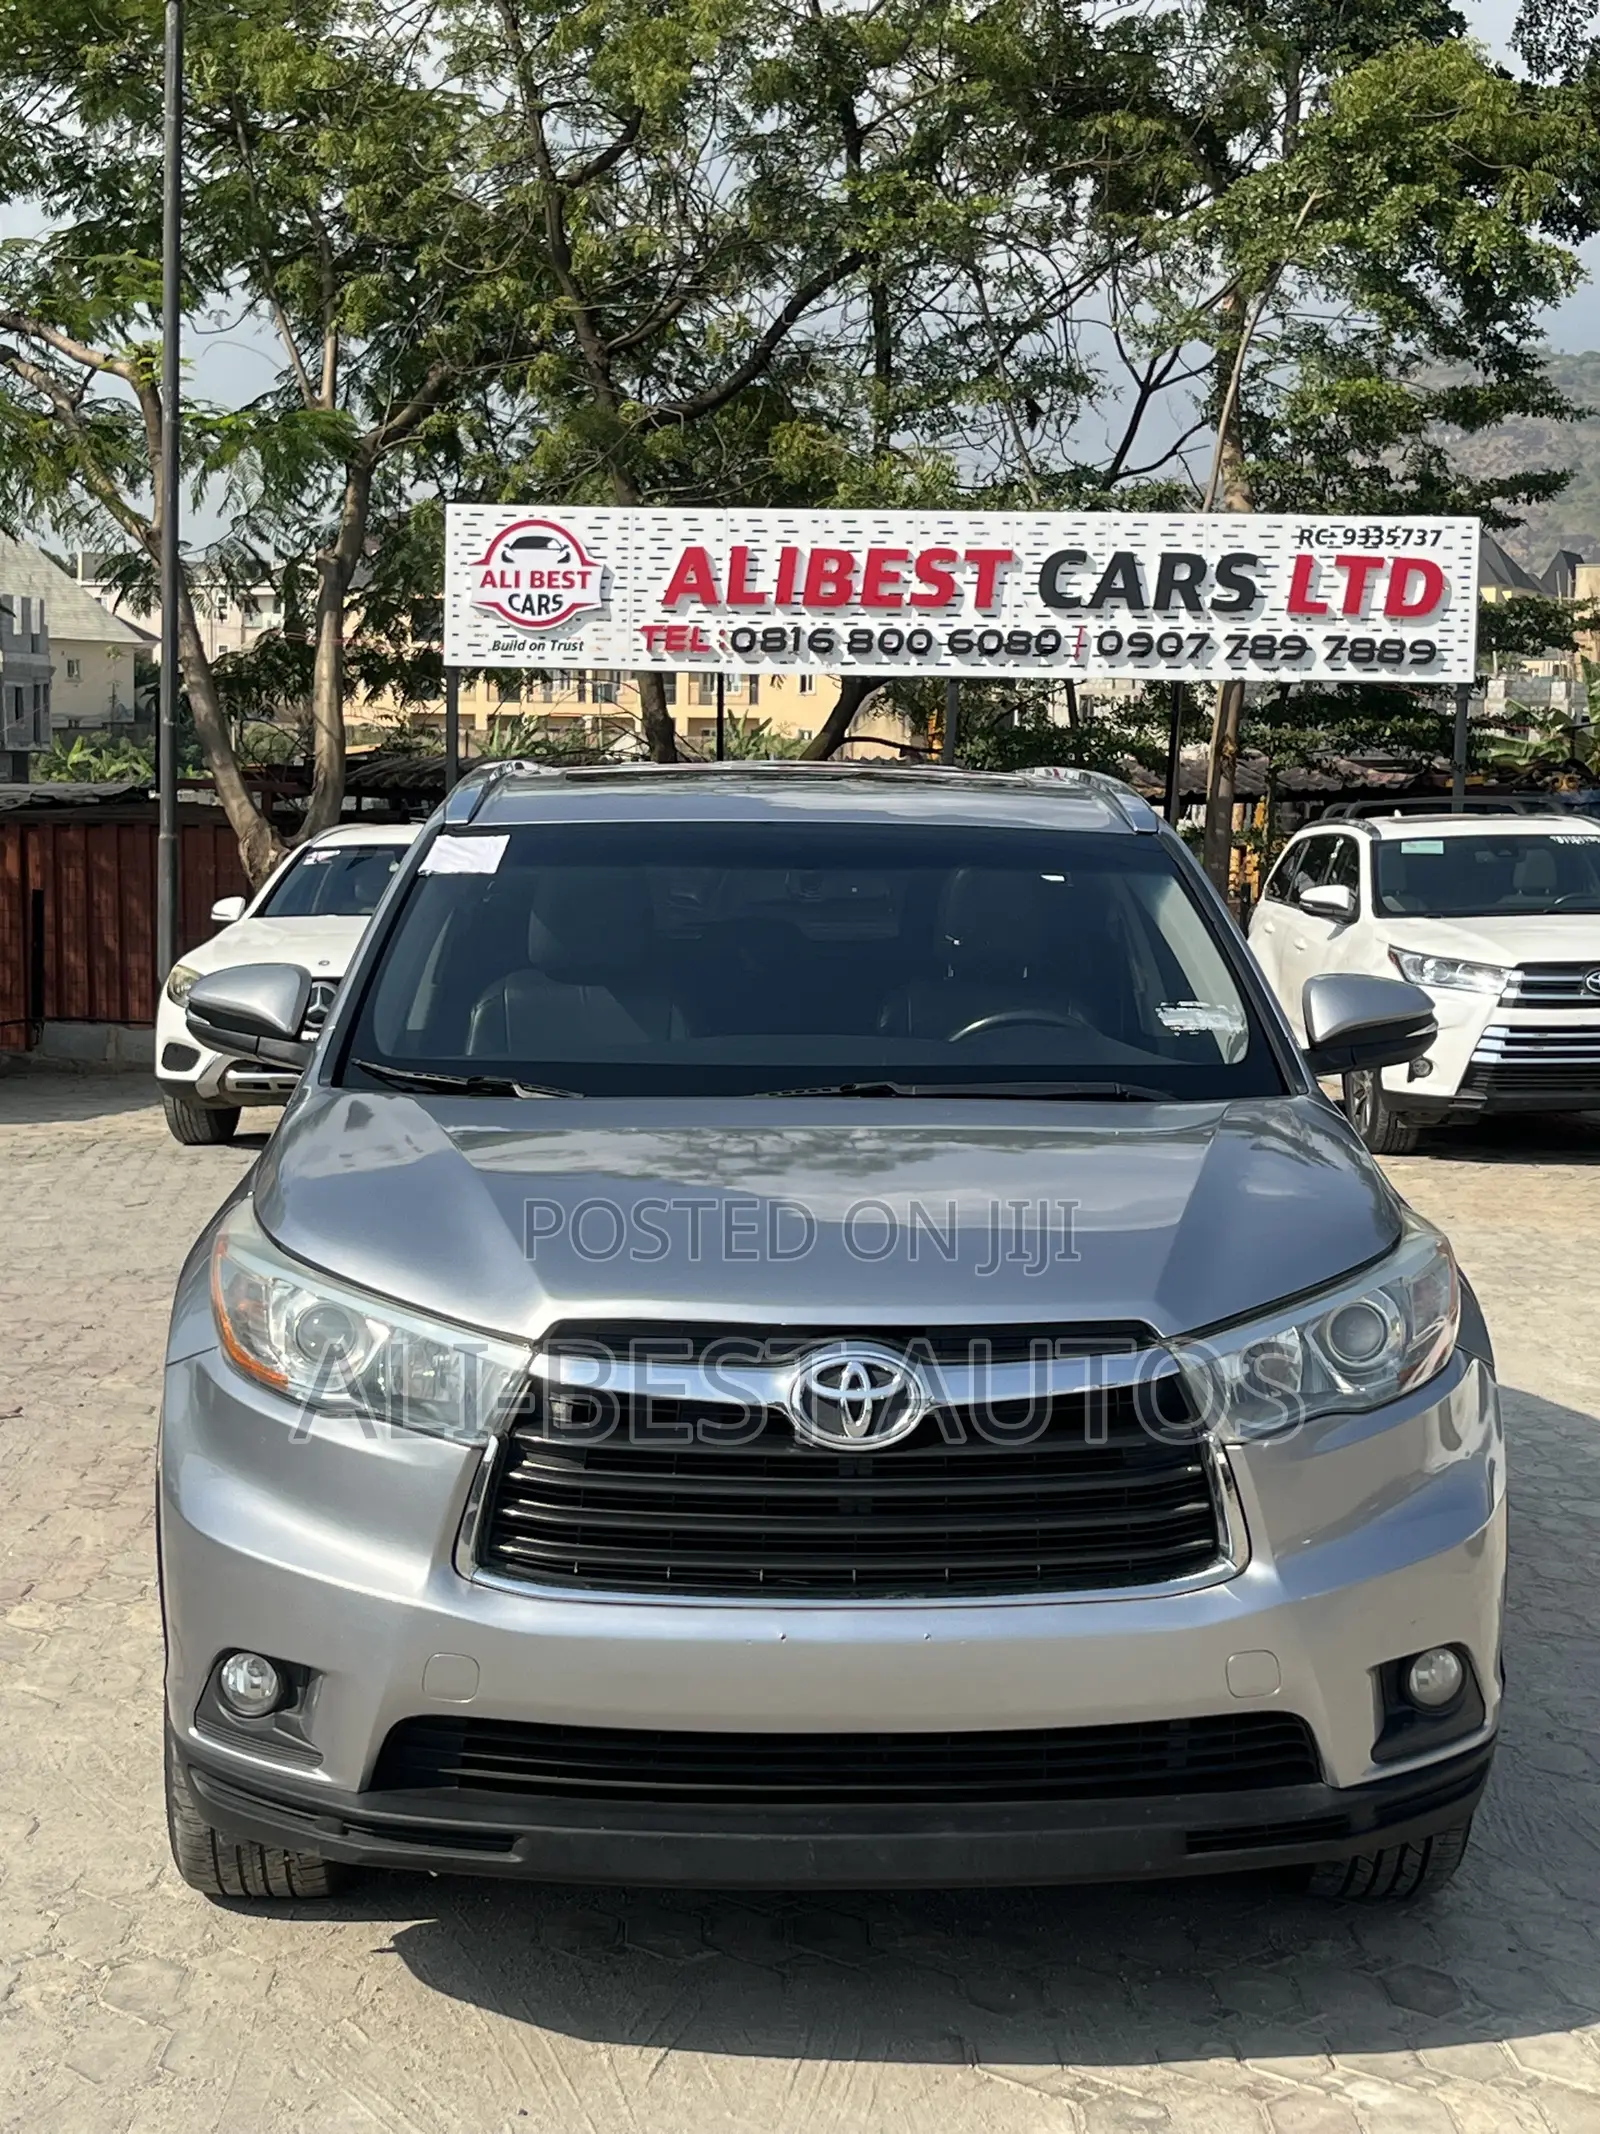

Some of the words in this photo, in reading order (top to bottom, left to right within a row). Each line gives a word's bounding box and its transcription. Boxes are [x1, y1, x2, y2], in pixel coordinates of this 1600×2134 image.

[1343, 528, 1443, 548] 9335737
[480, 570, 520, 589] ALI
[530, 570, 592, 589] BEST
[661, 545, 1014, 609] ALIBEST
[1038, 549, 1261, 613] CARS
[1286, 554, 1444, 618] LTD
[508, 593, 564, 616] CARS
[491, 640, 527, 652] Build
[529, 643, 545, 651] on
[550, 640, 584, 652] Trust
[730, 626, 835, 654] 0816
[847, 627, 933, 655] 800
[947, 628, 1062, 655] 6080
[1097, 629, 1211, 659] 0907
[1224, 633, 1309, 661] 789
[1323, 634, 1438, 665] 7889
